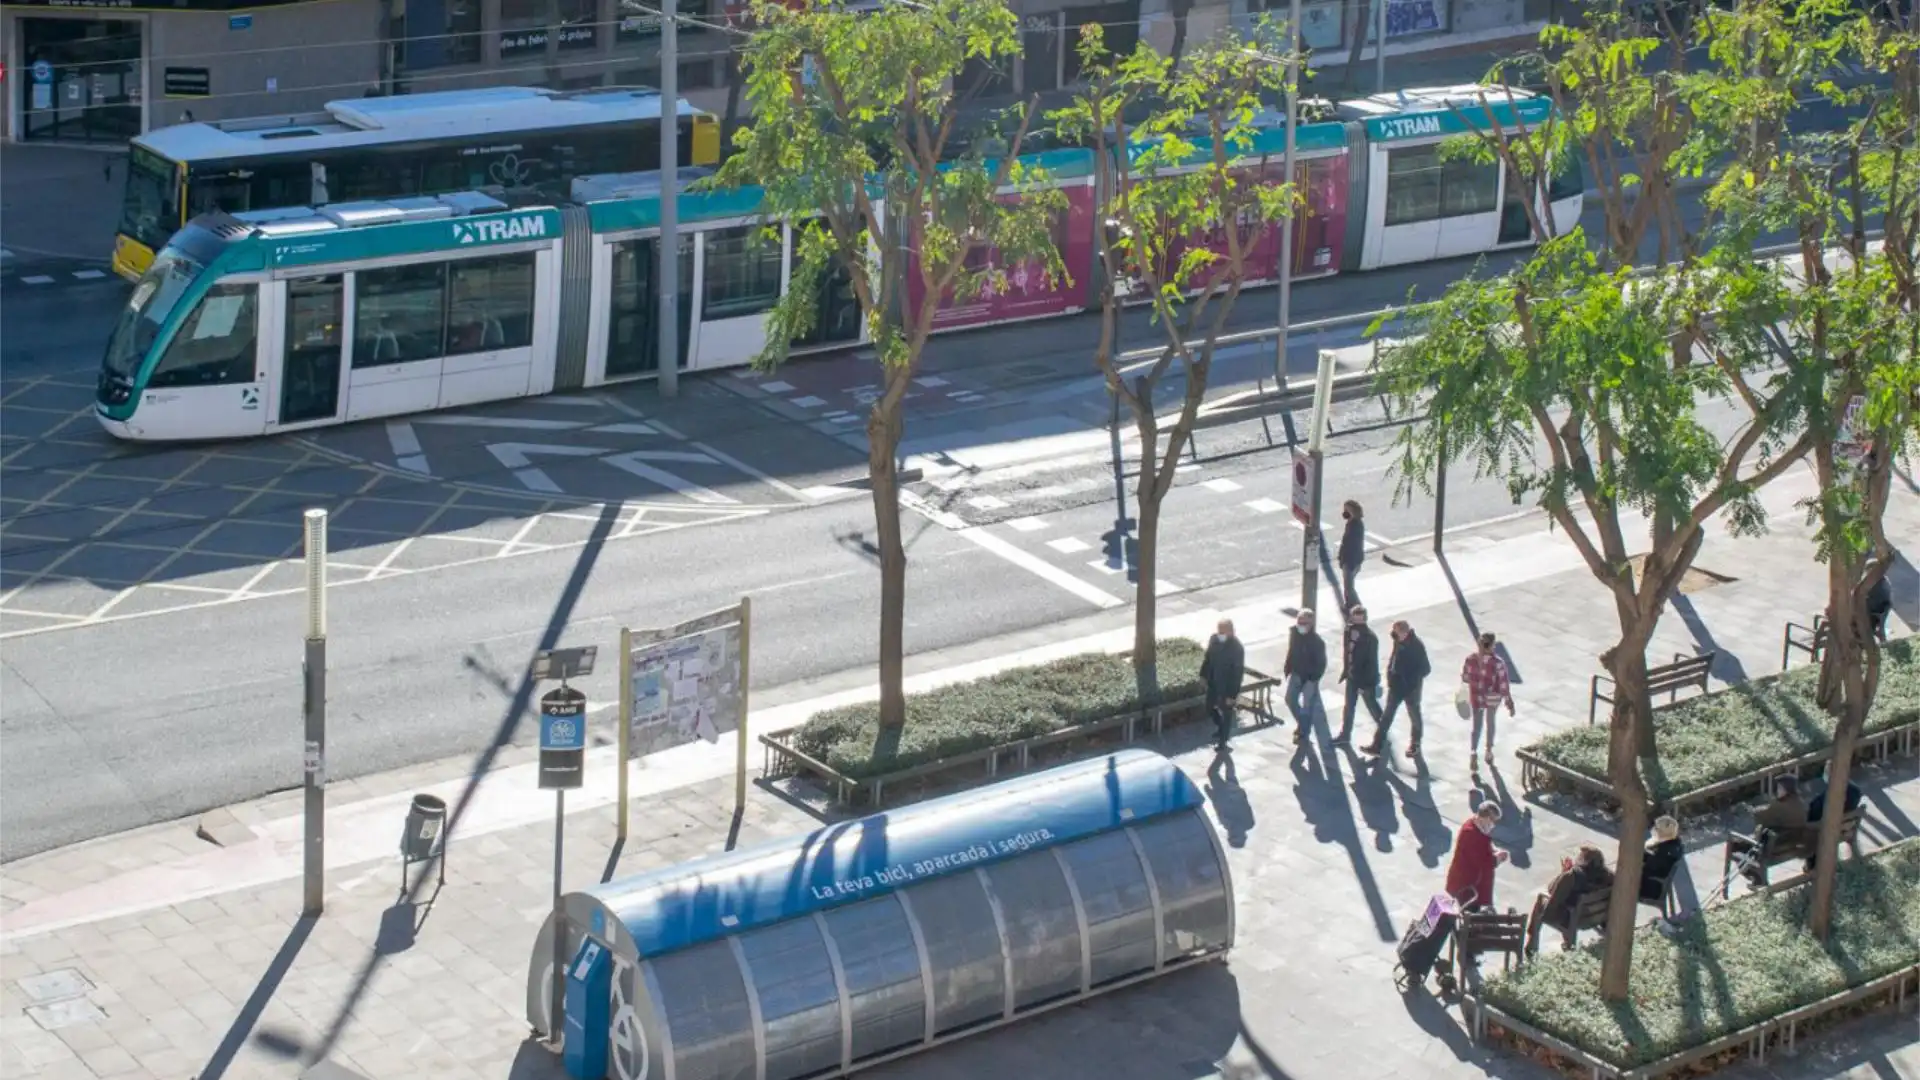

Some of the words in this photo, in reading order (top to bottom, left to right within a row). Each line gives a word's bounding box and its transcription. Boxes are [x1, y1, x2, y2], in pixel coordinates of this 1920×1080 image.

[1394, 116, 1441, 136] TRAM
[474, 215, 546, 241] TRAM
[812, 885, 834, 899] La
[836, 875, 874, 894] teva
[876, 863, 913, 885] bici,
[914, 843, 989, 876] aparcada
[991, 841, 998, 855] i
[999, 826, 1055, 853] segura.
